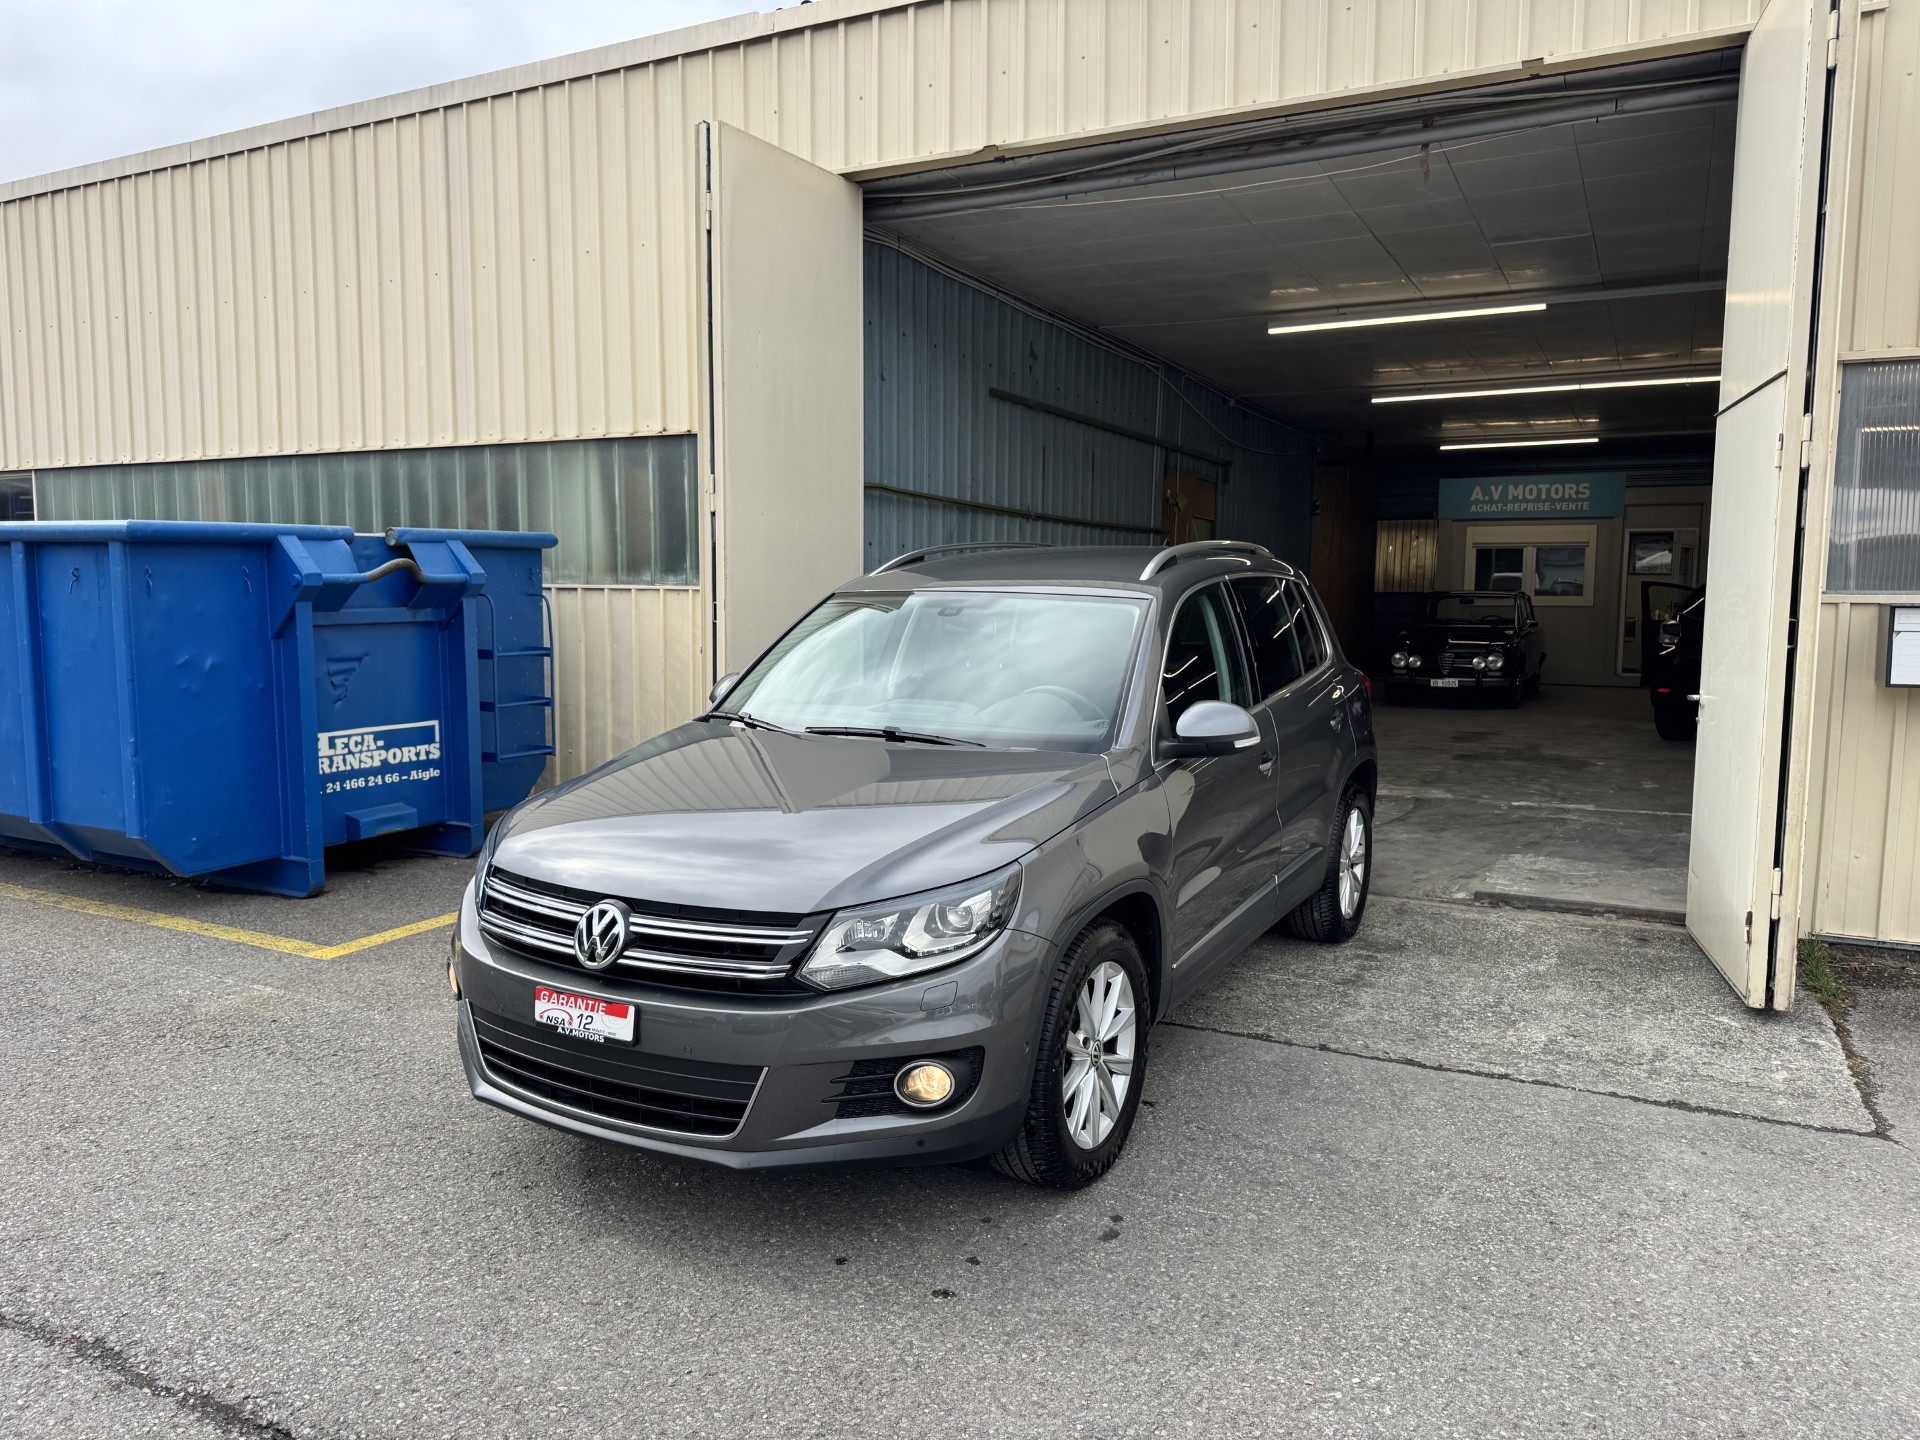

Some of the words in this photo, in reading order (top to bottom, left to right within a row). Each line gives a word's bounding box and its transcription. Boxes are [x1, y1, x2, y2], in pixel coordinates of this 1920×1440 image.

[1470, 485, 1504, 501] A.V
[1508, 483, 1591, 500] MOTORS
[1469, 501, 1591, 513] ACHAT-REPRISE-VENTE
[319, 743, 441, 774] RANSPORTS
[343, 776, 366, 791] 466
[368, 774, 383, 788] 24
[540, 991, 607, 1015] GARANTIE
[545, 1015, 566, 1027] NSA
[576, 1013, 594, 1031] 12
[557, 1027, 605, 1042] A.V.MOTORS
